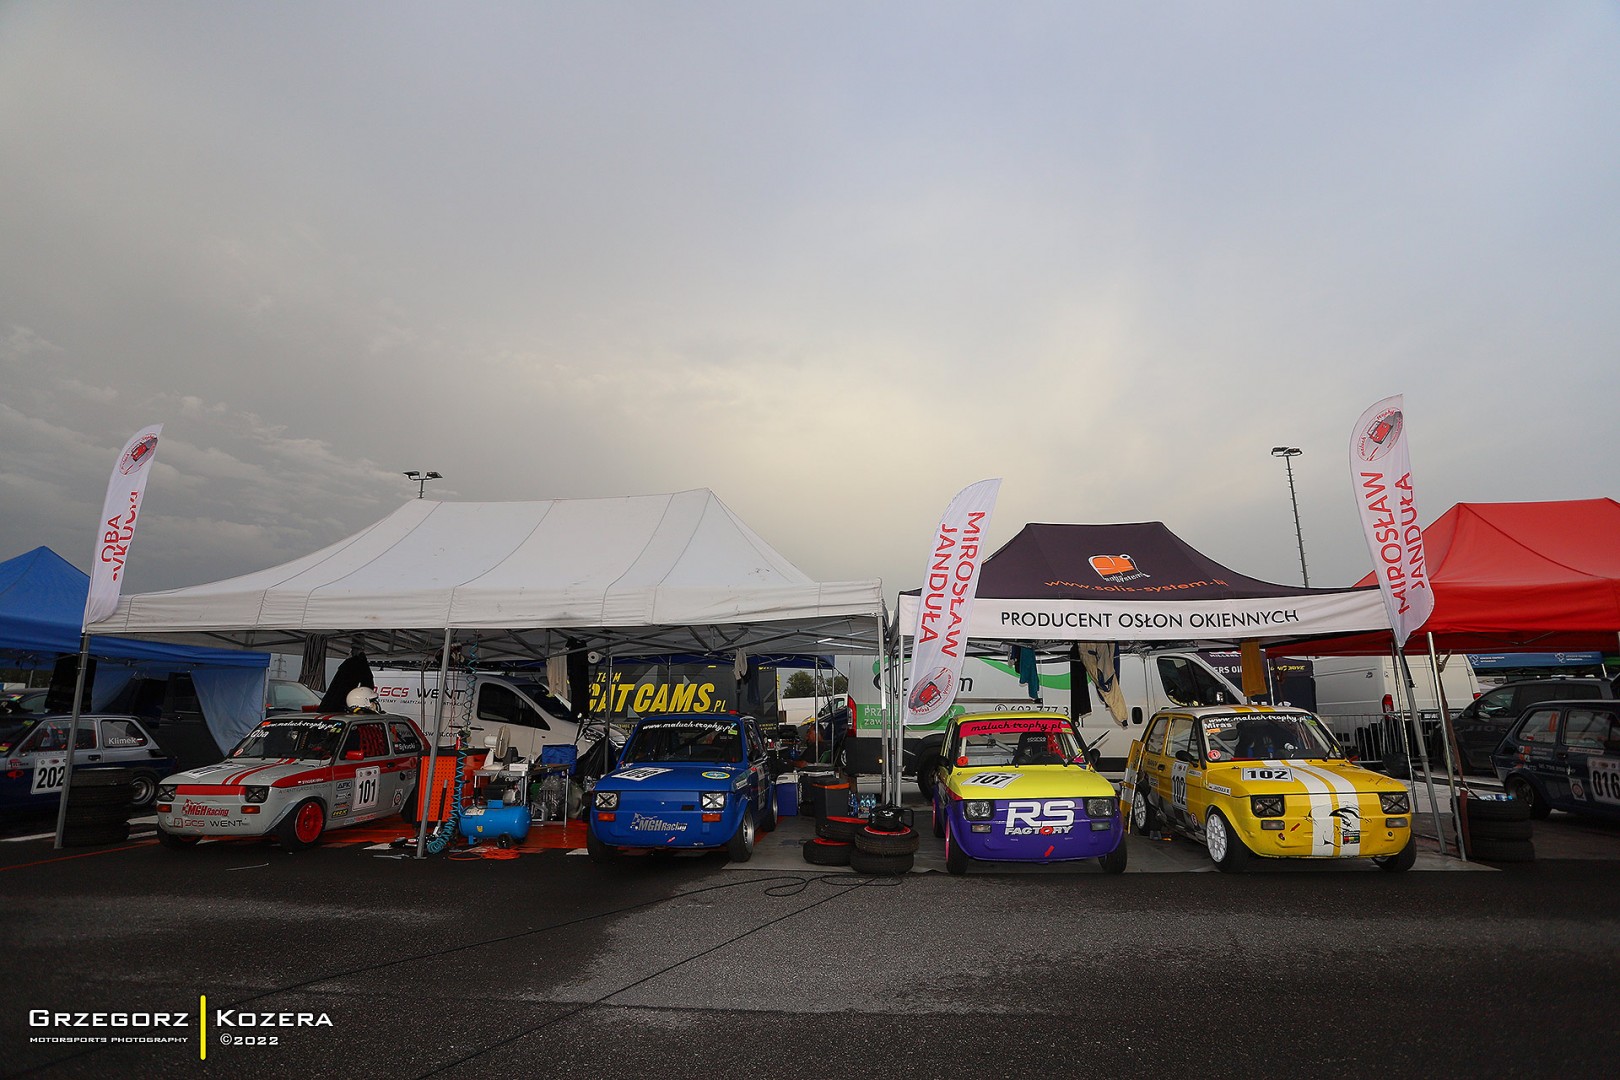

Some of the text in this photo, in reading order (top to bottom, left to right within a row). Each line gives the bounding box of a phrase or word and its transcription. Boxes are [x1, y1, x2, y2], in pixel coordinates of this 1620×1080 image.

[1394, 472, 1426, 591] JANDUŁA
[1360, 472, 1410, 615] MIROSŁAW
[919, 523, 958, 644] JANDUŁA
[941, 511, 986, 658] MIROSŁAW
[1001, 609, 1300, 628] PRODUCENT OSŁON OKIENNYCH
[596, 672, 622, 683] TEM
[380, 687, 466, 700] SCS WENT
[971, 721, 1062, 732] maluch-trophy.pl
[251, 729, 270, 738] Qba
[108, 737, 137, 745] Klimek
[971, 774, 1013, 785] 107
[1247, 770, 1288, 780] 102
[359, 779, 376, 804] 101
[1172, 775, 1186, 806] 102
[1006, 800, 1076, 828] RS
[184, 819, 242, 828] SCS WENT
[1004, 826, 1074, 836] FACTORY
